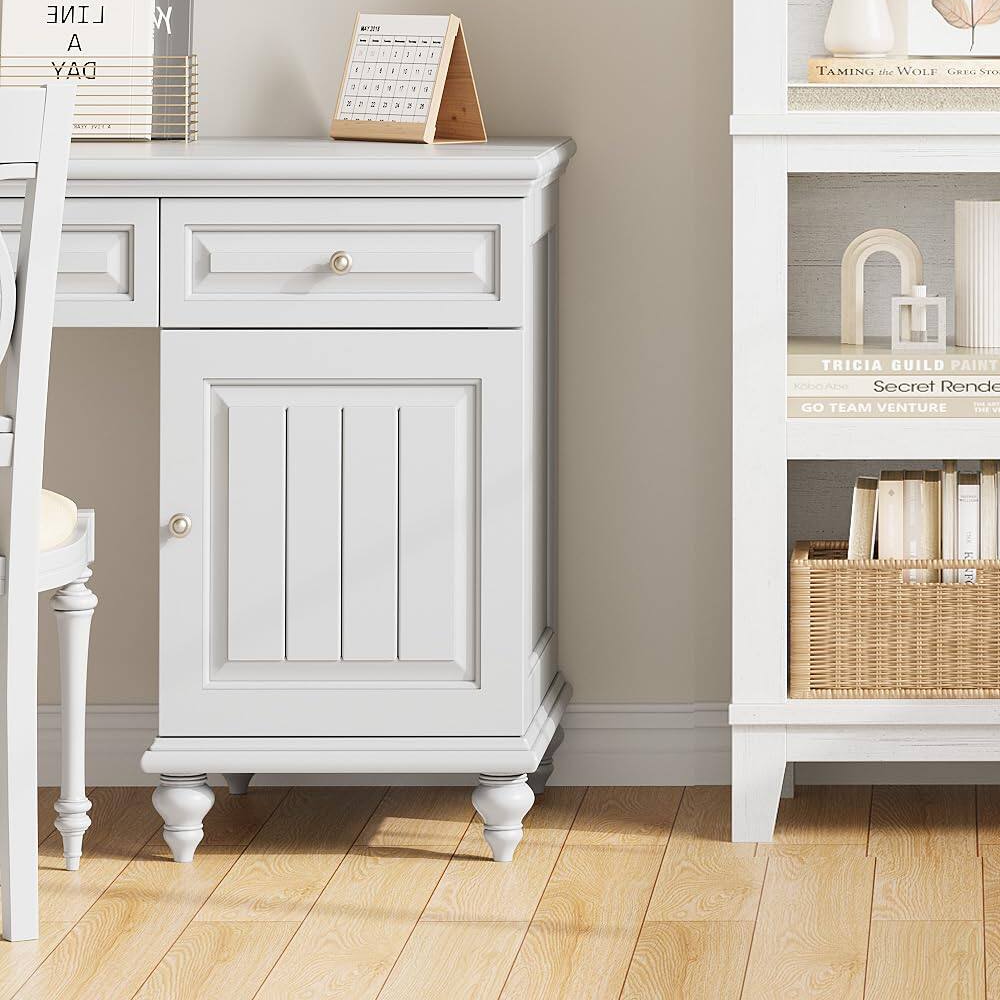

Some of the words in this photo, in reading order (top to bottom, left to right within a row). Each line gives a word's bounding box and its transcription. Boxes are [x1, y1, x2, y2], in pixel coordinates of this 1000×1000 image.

[816, 65, 874, 76] TAMING
[878, 66, 894, 76] the
[896, 65, 937, 76] WOLF
[821, 360, 881, 371] TRICIA
[891, 360, 945, 371] GUILD
[951, 360, 997, 371] PAINT
[873, 380, 935, 393] Secret
[801, 402, 826, 413] GO
[829, 402, 872, 413] TEAM
[876, 402, 947, 413] VENTURE
